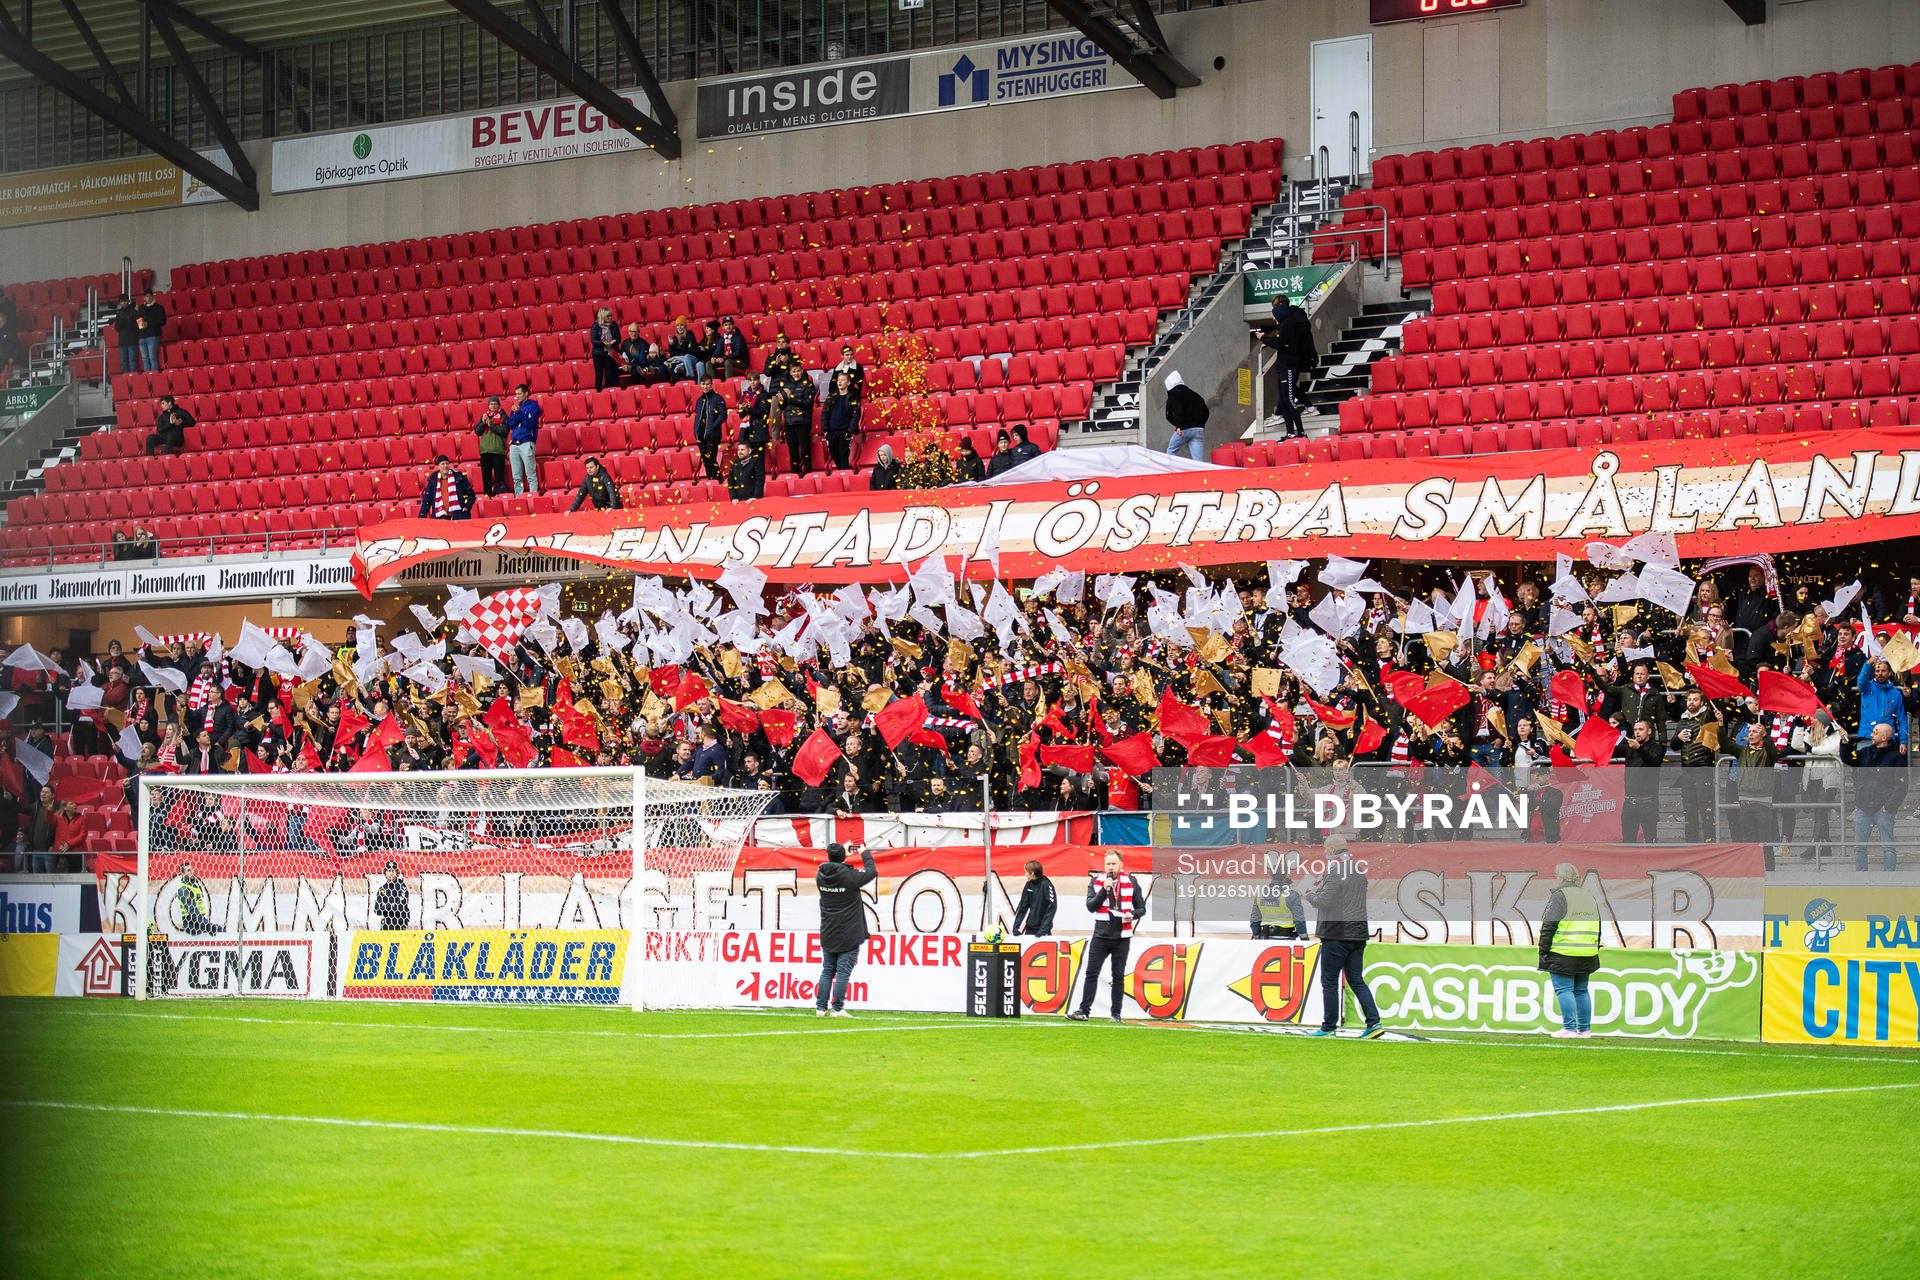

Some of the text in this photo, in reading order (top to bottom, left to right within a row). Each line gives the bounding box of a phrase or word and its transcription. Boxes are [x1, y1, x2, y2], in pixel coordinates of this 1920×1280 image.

[997, 68, 1107, 99] STENHUGGERI
[728, 106, 877, 134] QUALITY MENS CLOTHES
[474, 137, 631, 168] BYGGPLÅT VENTILATION ISOLERING
[15, 181, 71, 198] BORTAMATCH
[80, 175, 136, 190] VÄLKOMMEN
[138, 171, 153, 183] TILL
[155, 167, 177, 181] OSS!
[315, 157, 409, 184] Björkegrens Optik
[1254, 277, 1289, 291] ÅBRO
[714, 505, 951, 569] STAD
[1033, 480, 1353, 559] ÖSTRA
[49, 577, 121, 600] Barometern
[131, 572, 206, 595] Barometern
[218, 567, 295, 590] Barometern
[1866, 914, 1920, 948] RA
[353, 932, 617, 981] BLÅKLÄDER
[769, 931, 962, 967] ELERIKER
[166, 949, 299, 990] YGMA
[457, 988, 586, 1000] WORKWEAR
[974, 959, 988, 1016] SELECT
[1003, 959, 1015, 1016] SELECT
